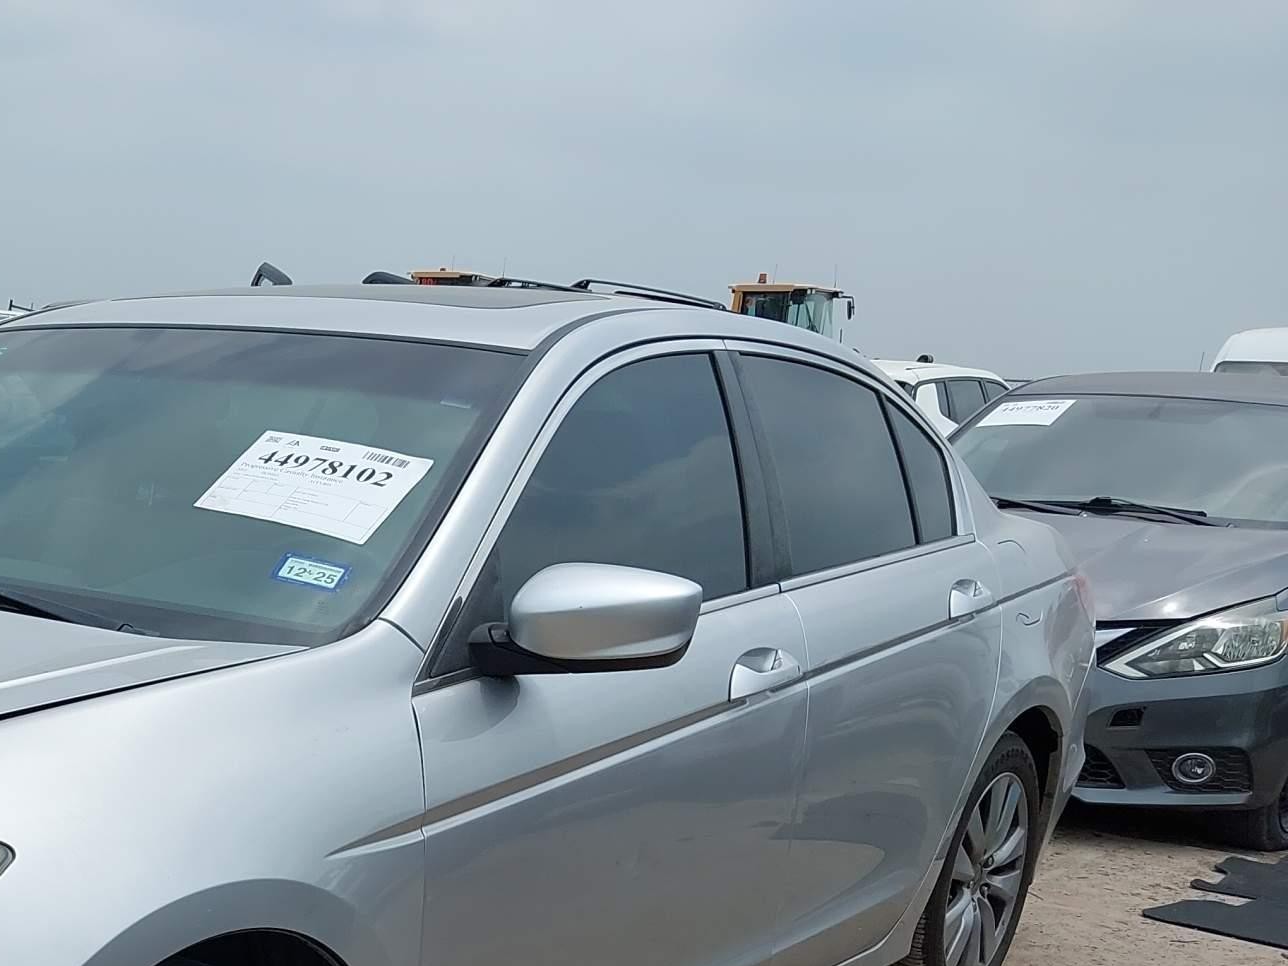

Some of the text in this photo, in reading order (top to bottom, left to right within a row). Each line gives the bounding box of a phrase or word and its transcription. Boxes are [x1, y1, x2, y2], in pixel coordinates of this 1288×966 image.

[258, 450, 394, 487] 44978102
[287, 565, 307, 578] 12
[313, 571, 338, 585] 25
